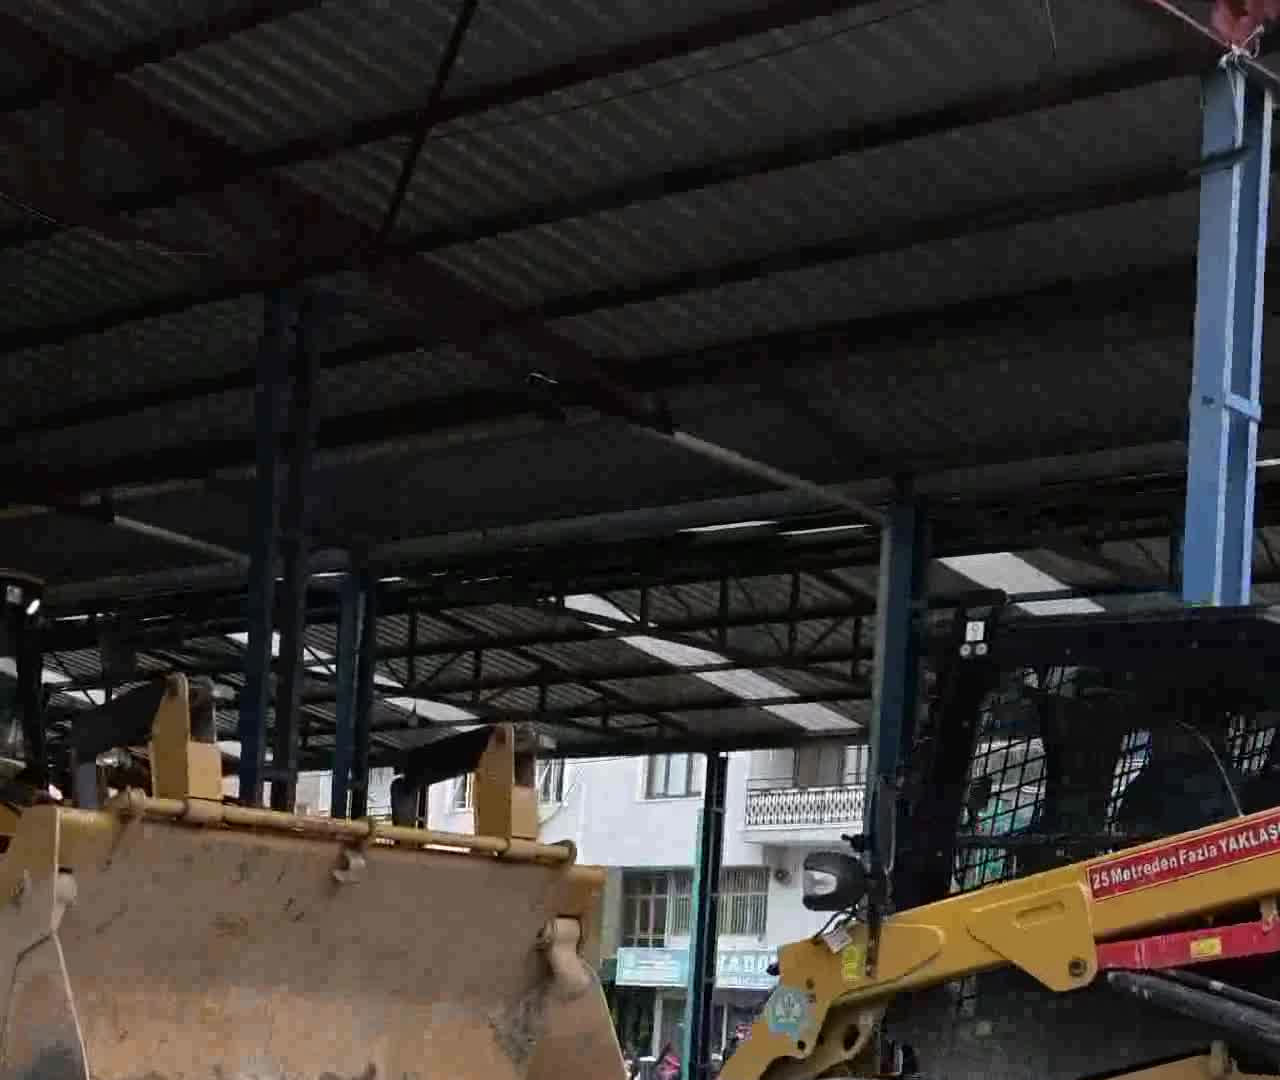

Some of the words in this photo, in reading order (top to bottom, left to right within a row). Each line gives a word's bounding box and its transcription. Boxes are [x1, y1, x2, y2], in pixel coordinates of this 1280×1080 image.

[1091, 872, 1110, 890] 25
[1111, 854, 1179, 885] Metreden
[1179, 843, 1218, 866] Fazla
